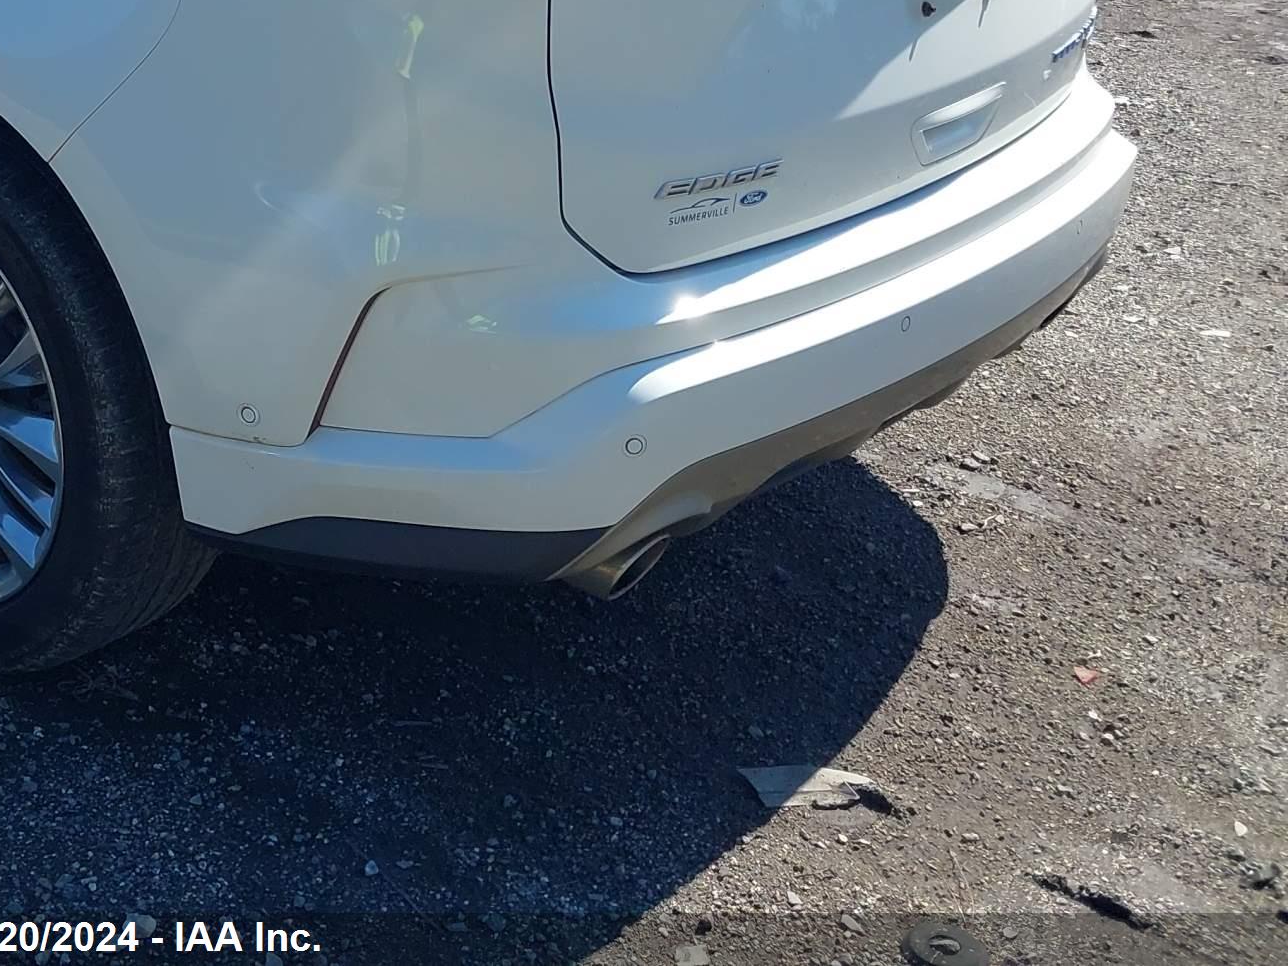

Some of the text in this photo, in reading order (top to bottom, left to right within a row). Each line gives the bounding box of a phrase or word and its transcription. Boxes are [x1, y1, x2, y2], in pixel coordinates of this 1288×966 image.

[653, 157, 785, 200] EDGE
[668, 191, 764, 226] SUMMERVILLE Ford
